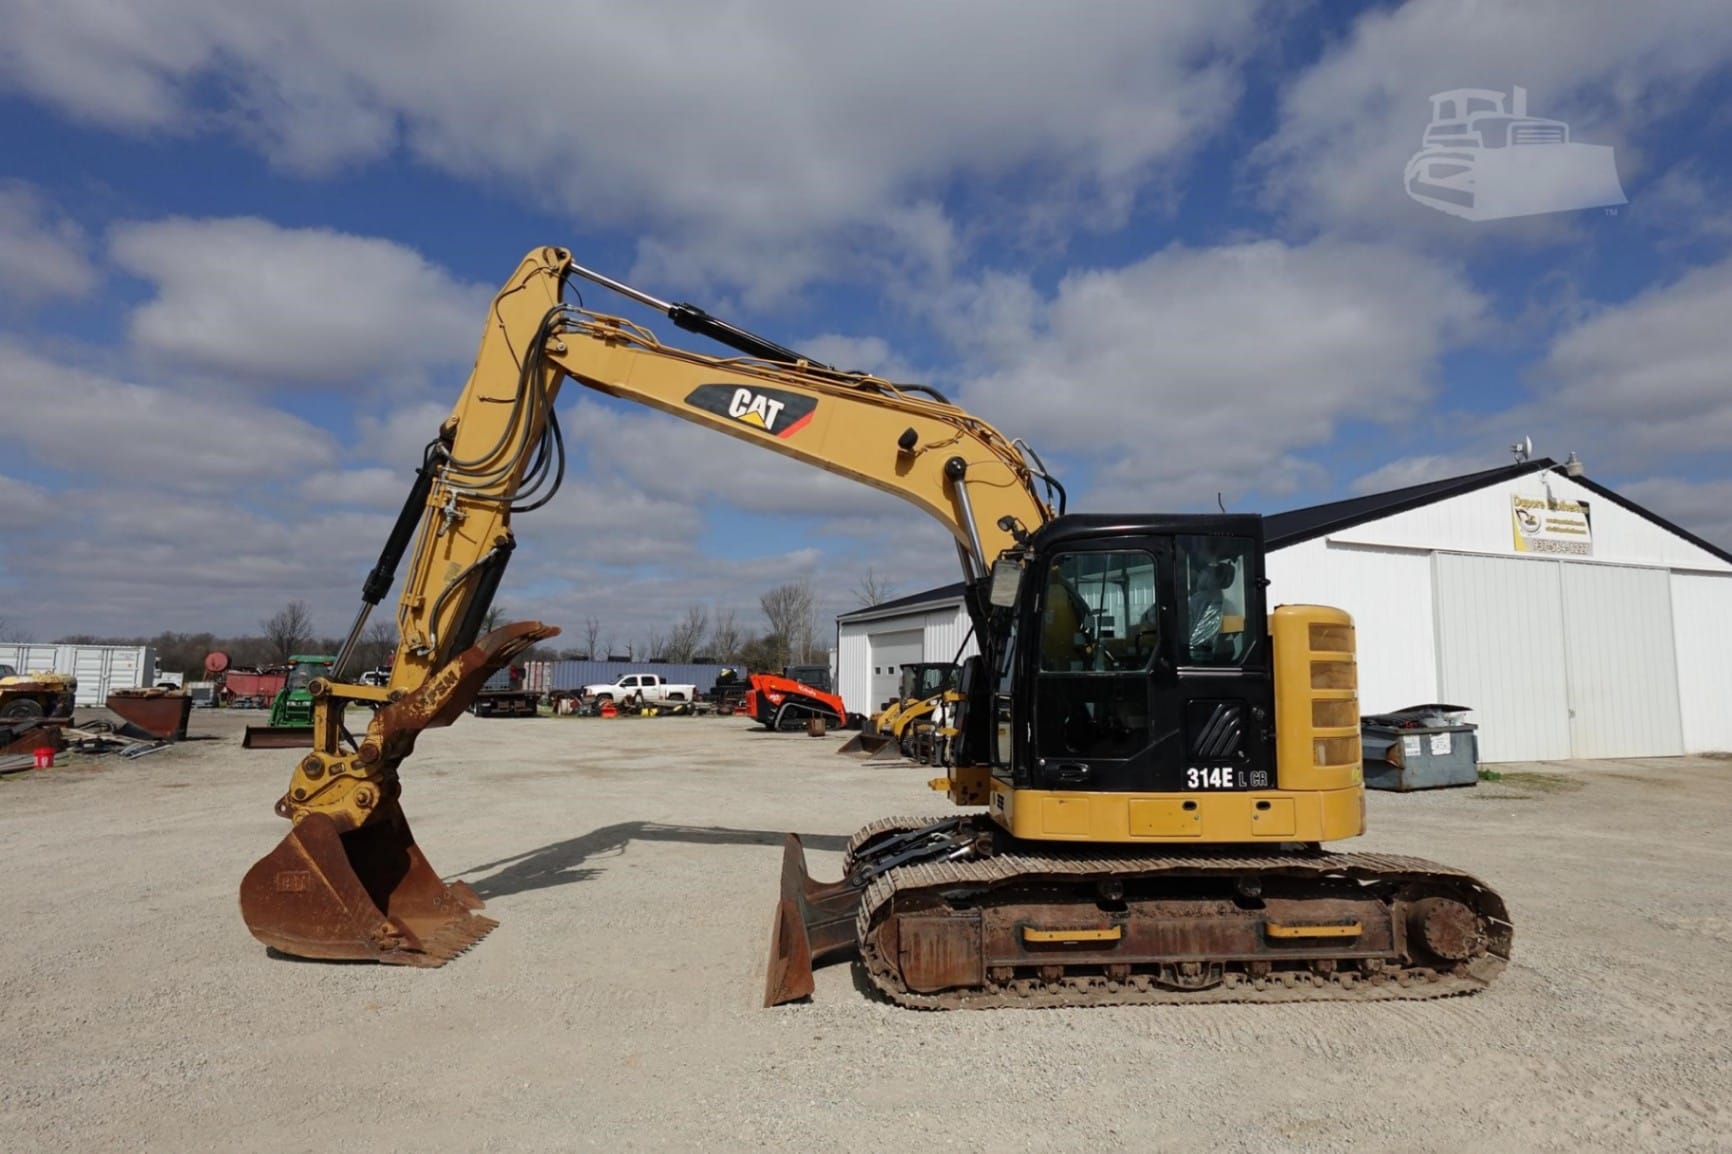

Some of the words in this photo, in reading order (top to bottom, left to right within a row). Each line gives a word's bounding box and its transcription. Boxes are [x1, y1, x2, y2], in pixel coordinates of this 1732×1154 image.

[728, 388, 784, 430] CAT
[1187, 767, 1233, 788] 314E
[1238, 771, 1247, 787] L
[1250, 770, 1268, 787] CR
